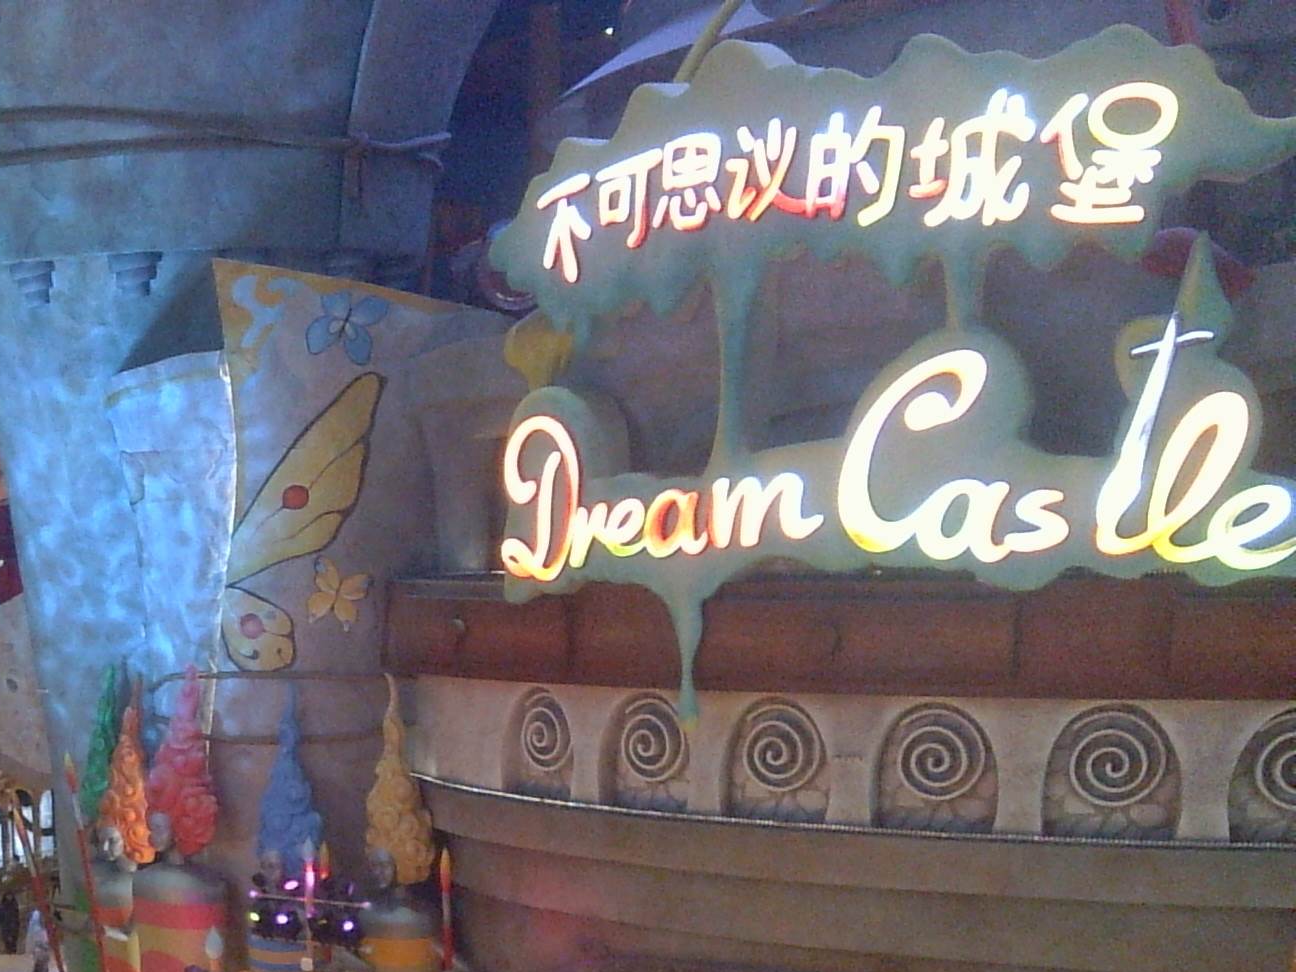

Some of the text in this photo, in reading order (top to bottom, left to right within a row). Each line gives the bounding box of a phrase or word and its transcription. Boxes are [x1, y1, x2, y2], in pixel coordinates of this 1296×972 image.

[536, 82, 1179, 283] 不可思议的城堡
[503, 314, 1296, 582] Dream Castle
